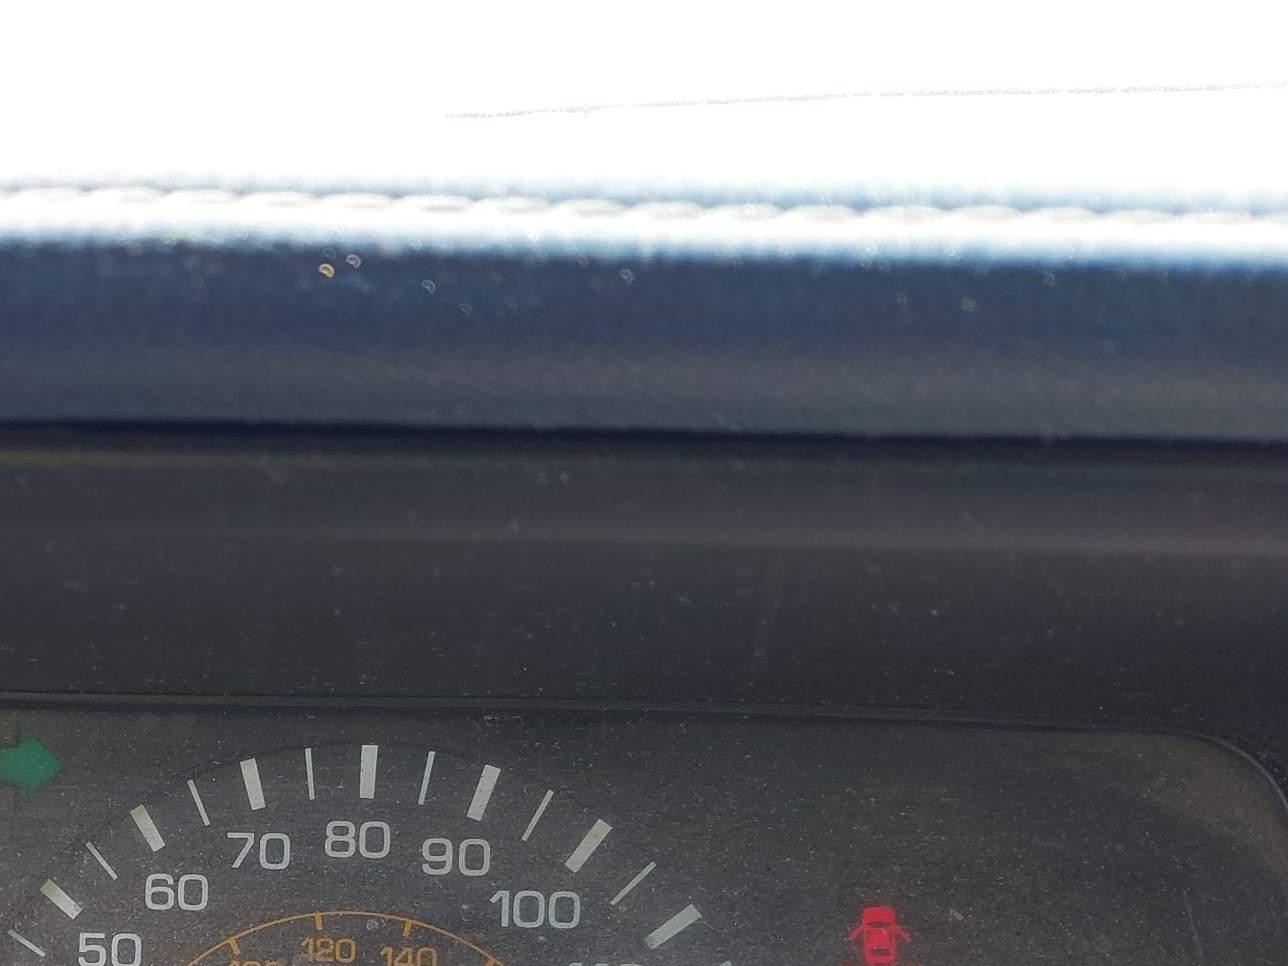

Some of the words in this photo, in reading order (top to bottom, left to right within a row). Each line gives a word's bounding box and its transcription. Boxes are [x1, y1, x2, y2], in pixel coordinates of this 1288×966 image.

[227, 832, 290, 870] 70
[325, 820, 391, 858] 80
[422, 838, 491, 876] 90
[145, 873, 208, 911] 60
[489, 890, 580, 929] 100
[305, 937, 357, 963] 120
